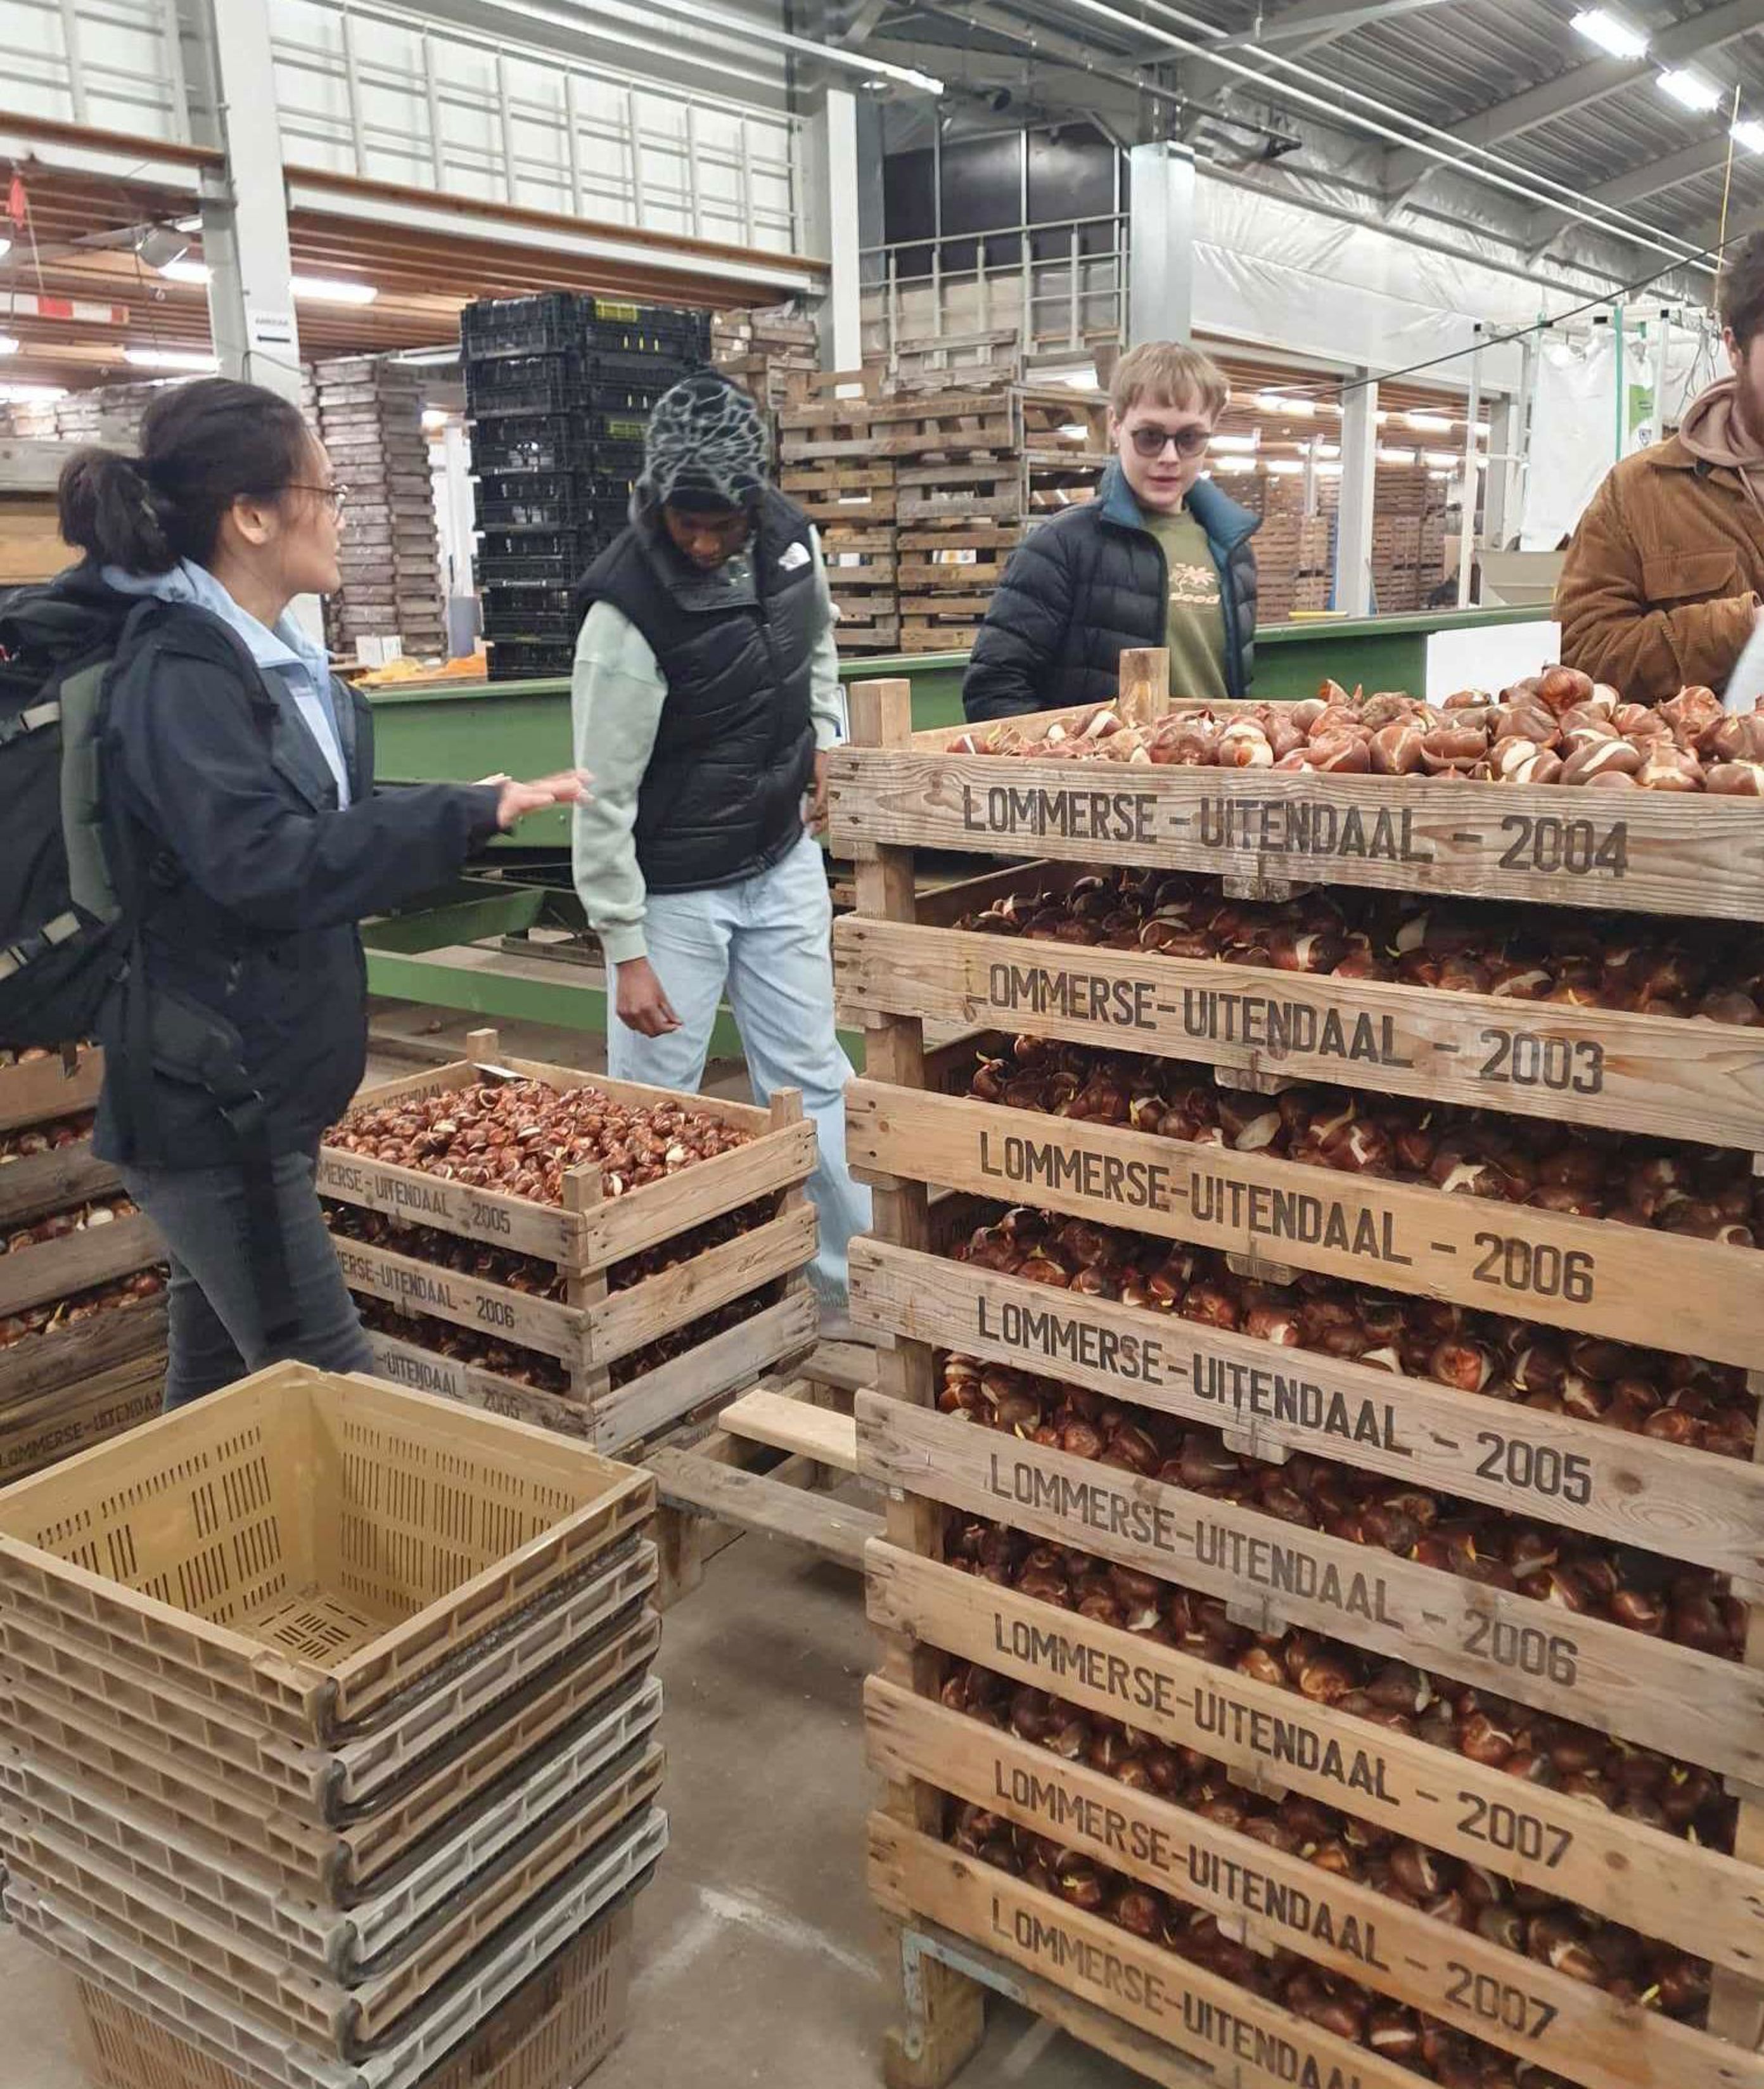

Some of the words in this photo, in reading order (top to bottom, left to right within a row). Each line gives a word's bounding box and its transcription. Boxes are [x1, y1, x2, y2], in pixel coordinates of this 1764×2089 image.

[1498, 815, 1628, 878] 2004
[1478, 1029, 1605, 1095] 2003
[471, 1201, 511, 1235] 2005
[1471, 1231, 1595, 1304] 2006
[476, 1295, 514, 1328] 2006
[1474, 1430, 1592, 1505] 2005
[1462, 1609, 1578, 1687] 2006
[1457, 1791, 1575, 1869] 2007
[991, 1897, 1360, 2089] LOMMERSE-UITENDAA
[1444, 1961, 1559, 2040] 2007
